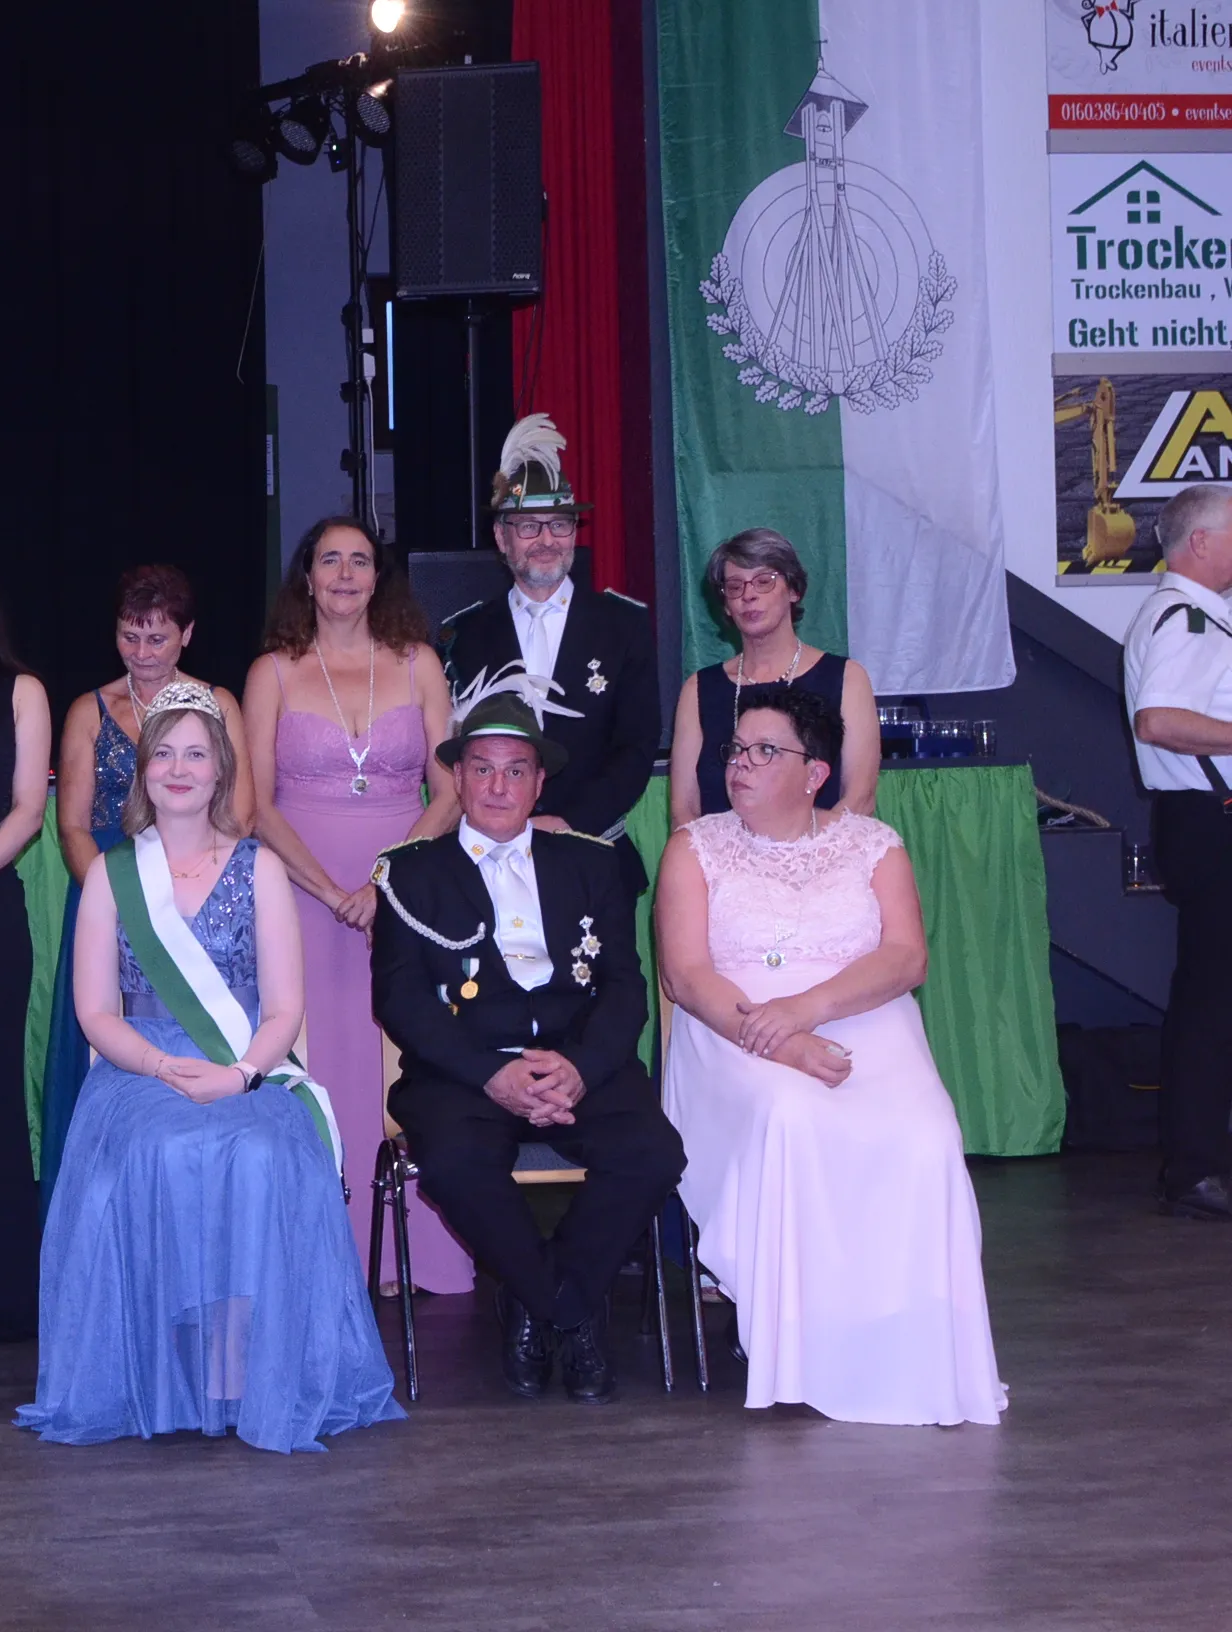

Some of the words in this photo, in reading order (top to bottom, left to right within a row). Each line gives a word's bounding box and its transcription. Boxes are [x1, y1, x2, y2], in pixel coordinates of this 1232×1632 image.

[1150, 8, 1232, 48] italie
[1066, 225, 1232, 270] Trocke
[1071, 278, 1201, 300] Trockenbau
[1068, 318, 1139, 348] Geht
